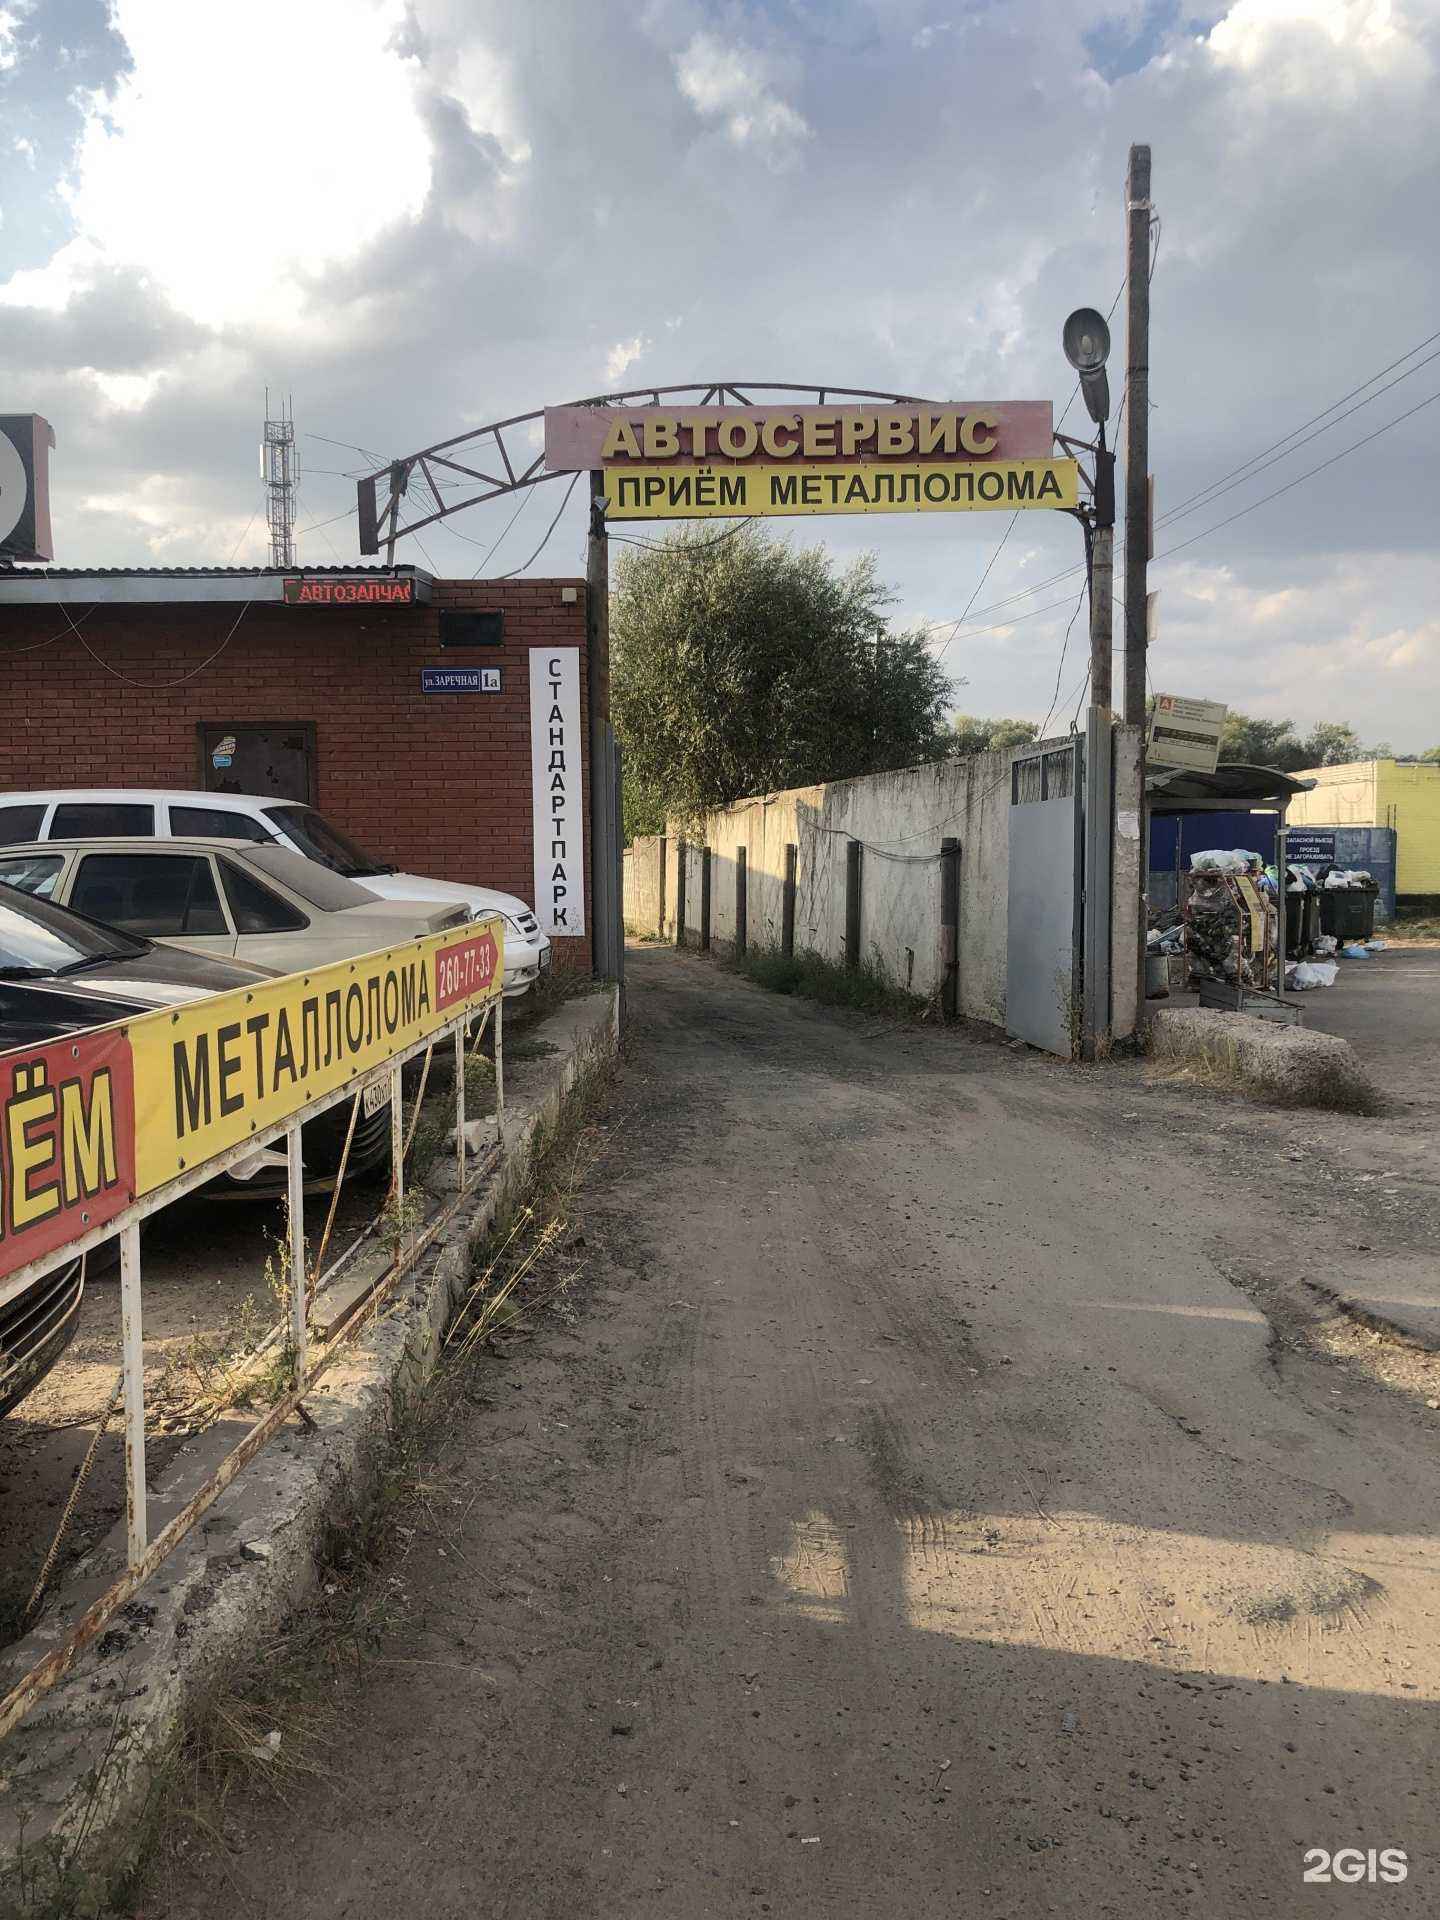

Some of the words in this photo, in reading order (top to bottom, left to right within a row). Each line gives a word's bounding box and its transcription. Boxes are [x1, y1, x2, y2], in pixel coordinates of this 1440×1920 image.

[601, 413, 998, 458] АВТОСЕРВИС
[618, 469, 747, 507] ПРИЁМ
[770, 470, 1063, 506] МЕТАЛЛОЛОМА
[548, 658, 568, 927] СТАНДАРТПАРК
[439, 943, 490, 999] 260-77-33
[173, 959, 430, 1139] МЕТАЛЛОЛОМА
